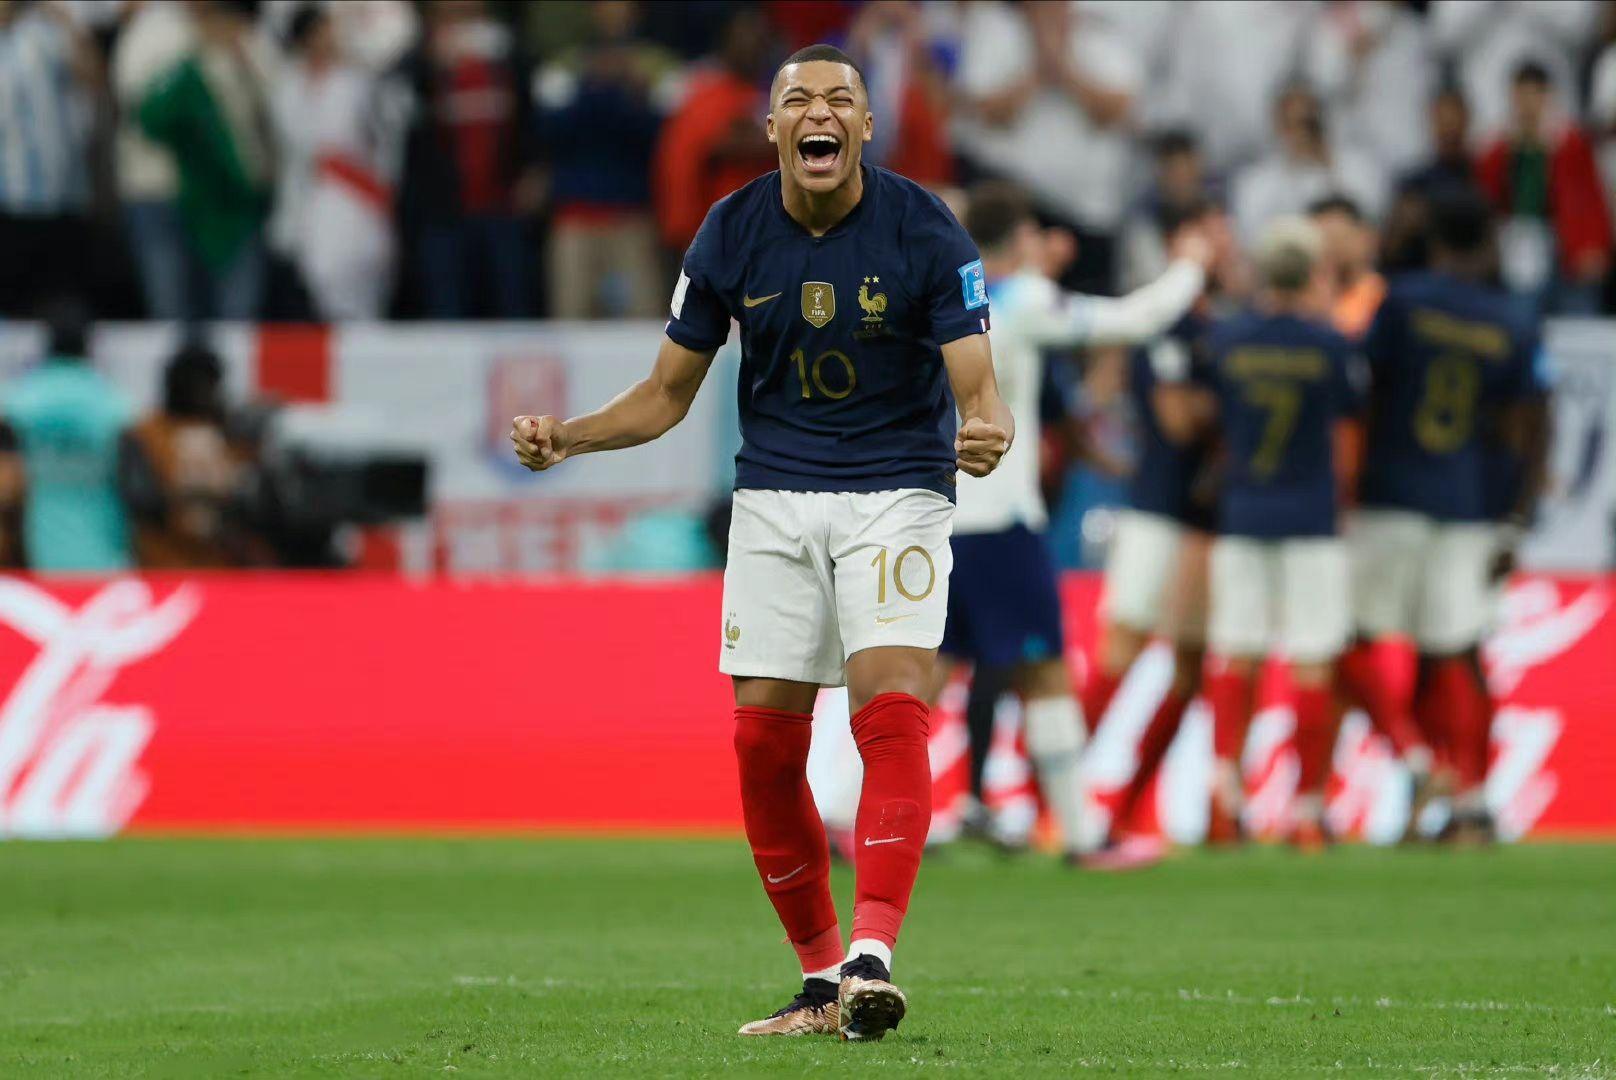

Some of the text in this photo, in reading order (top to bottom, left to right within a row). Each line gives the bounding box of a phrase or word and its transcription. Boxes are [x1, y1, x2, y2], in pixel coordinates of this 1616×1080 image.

[789, 348, 856, 399] 10
[1415, 358, 1477, 453] 8
[1245, 381, 1301, 479] 7
[870, 545, 936, 604] 10
